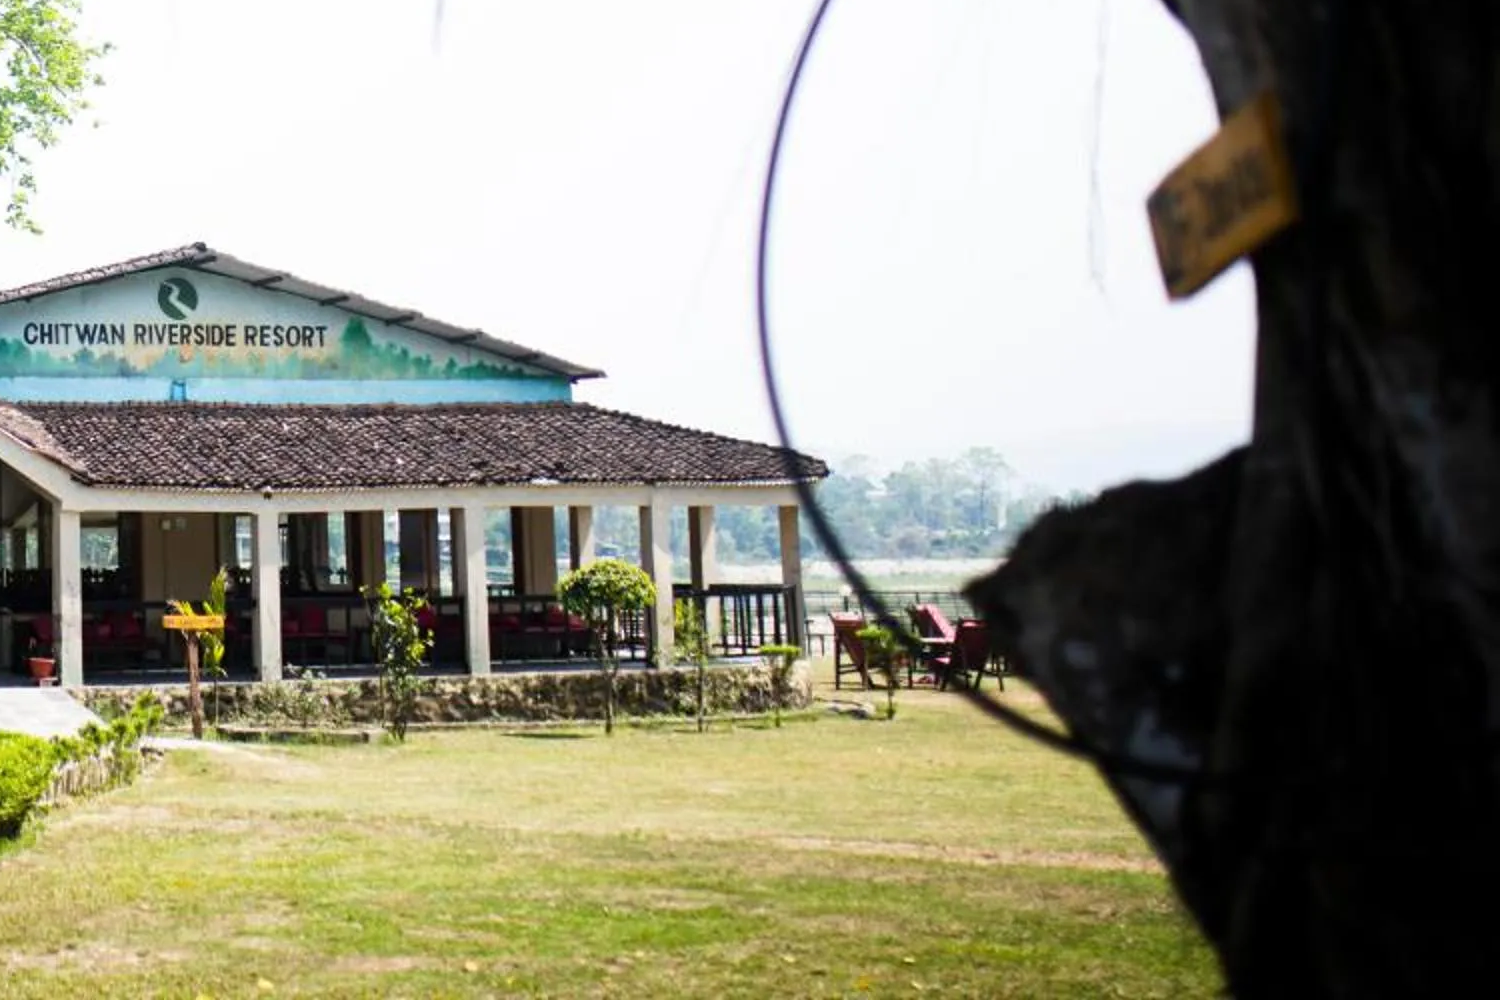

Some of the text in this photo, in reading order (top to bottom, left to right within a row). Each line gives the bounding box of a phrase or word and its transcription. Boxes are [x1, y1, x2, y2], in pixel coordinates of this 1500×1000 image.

[23, 322, 328, 348] CHITWAN RIVERSIDE RESORT
